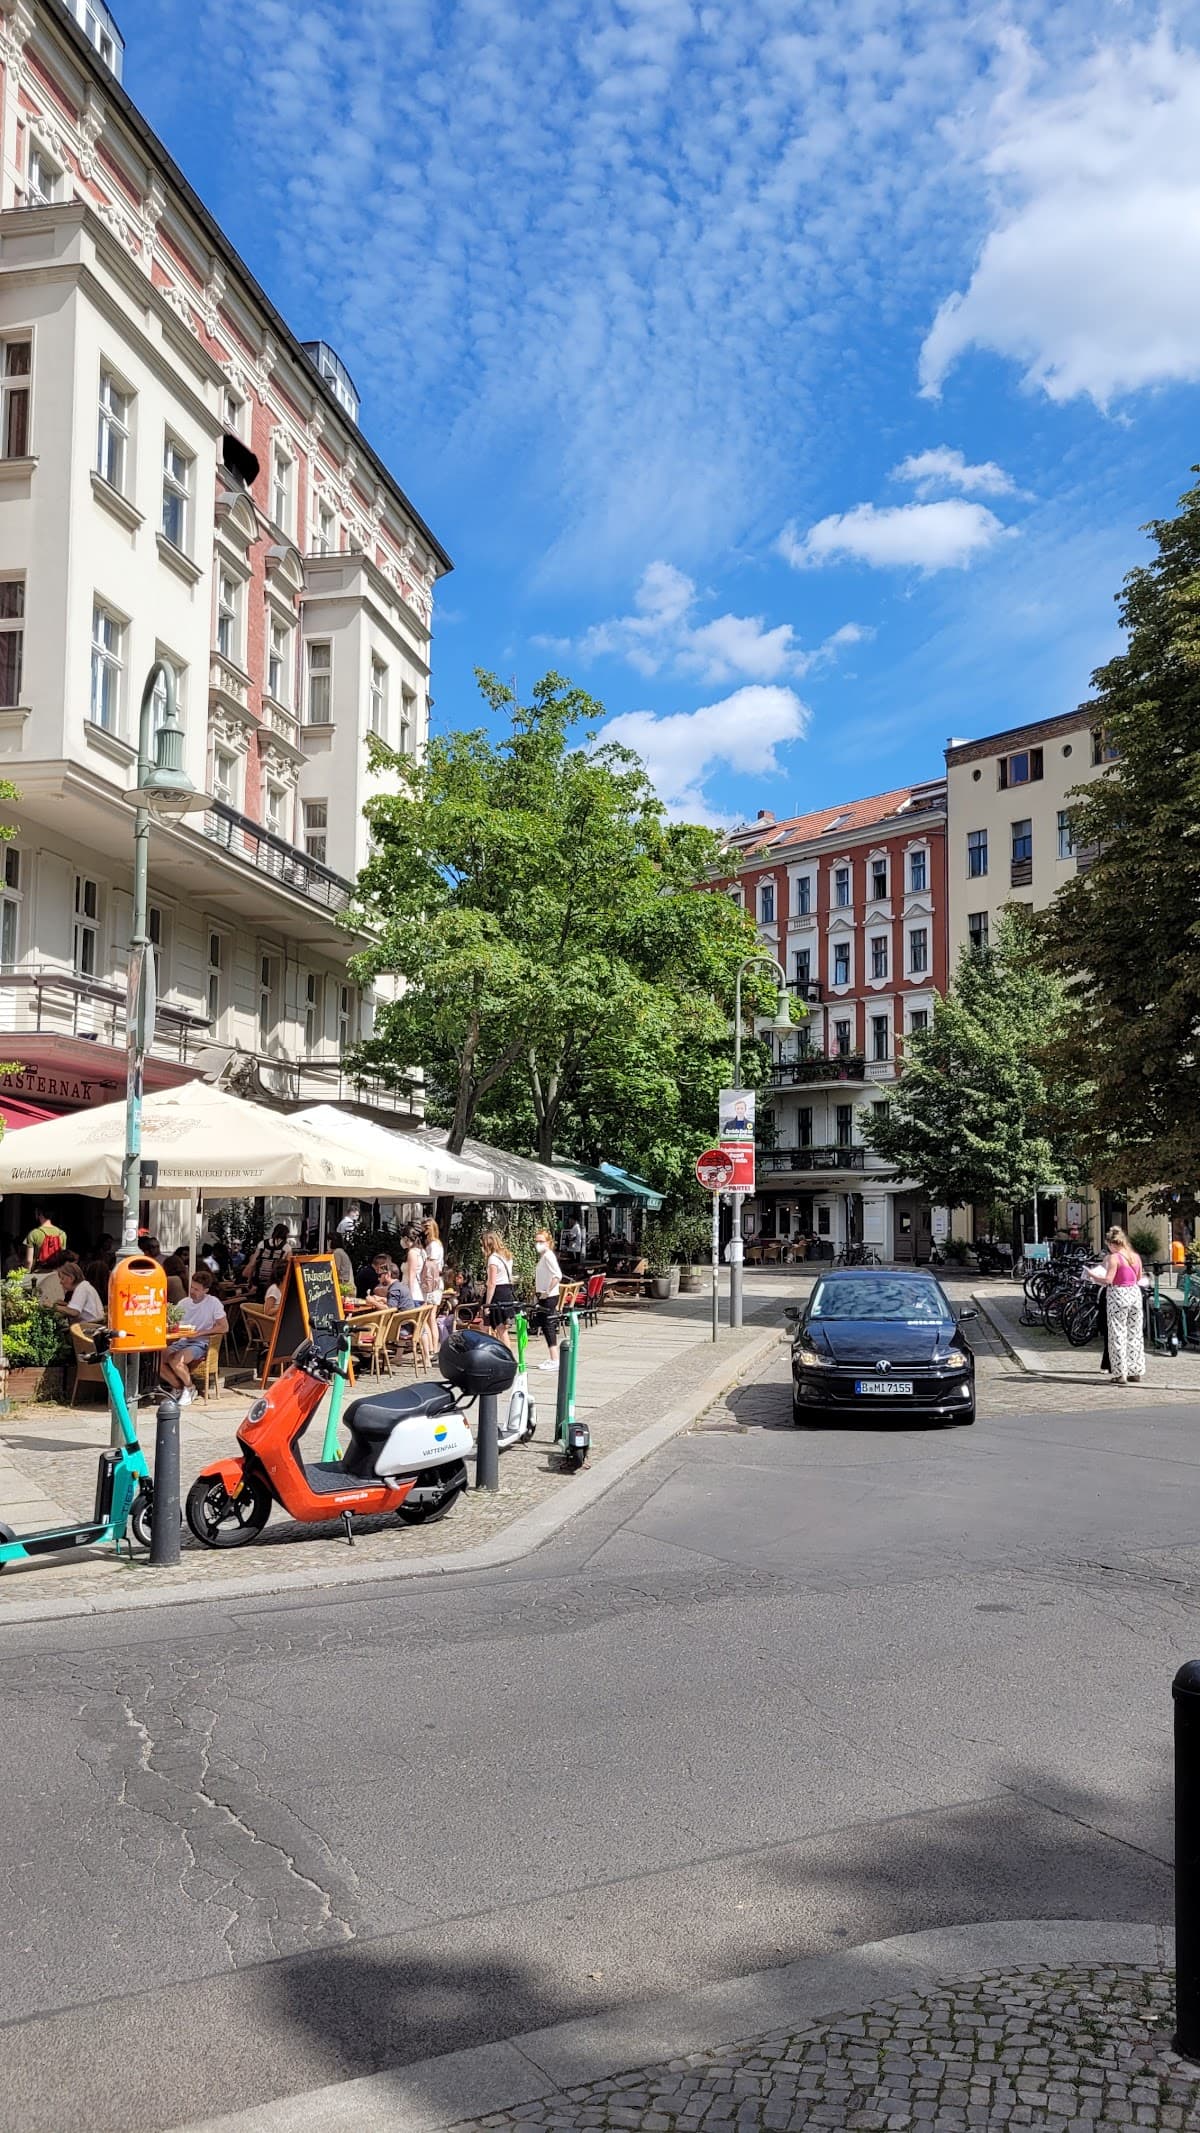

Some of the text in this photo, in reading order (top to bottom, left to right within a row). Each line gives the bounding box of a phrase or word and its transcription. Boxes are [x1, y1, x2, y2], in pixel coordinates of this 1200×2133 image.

[1, 1073, 93, 1100] ASTERNAK
[11, 1165, 72, 1180] Weihenstephan
[184, 1169, 223, 1177] BRAUEREI
[242, 1169, 265, 1177] WELT
[422, 1442, 458, 1457] VATTENFALL
[121, 1484, 134, 1514] TIER
